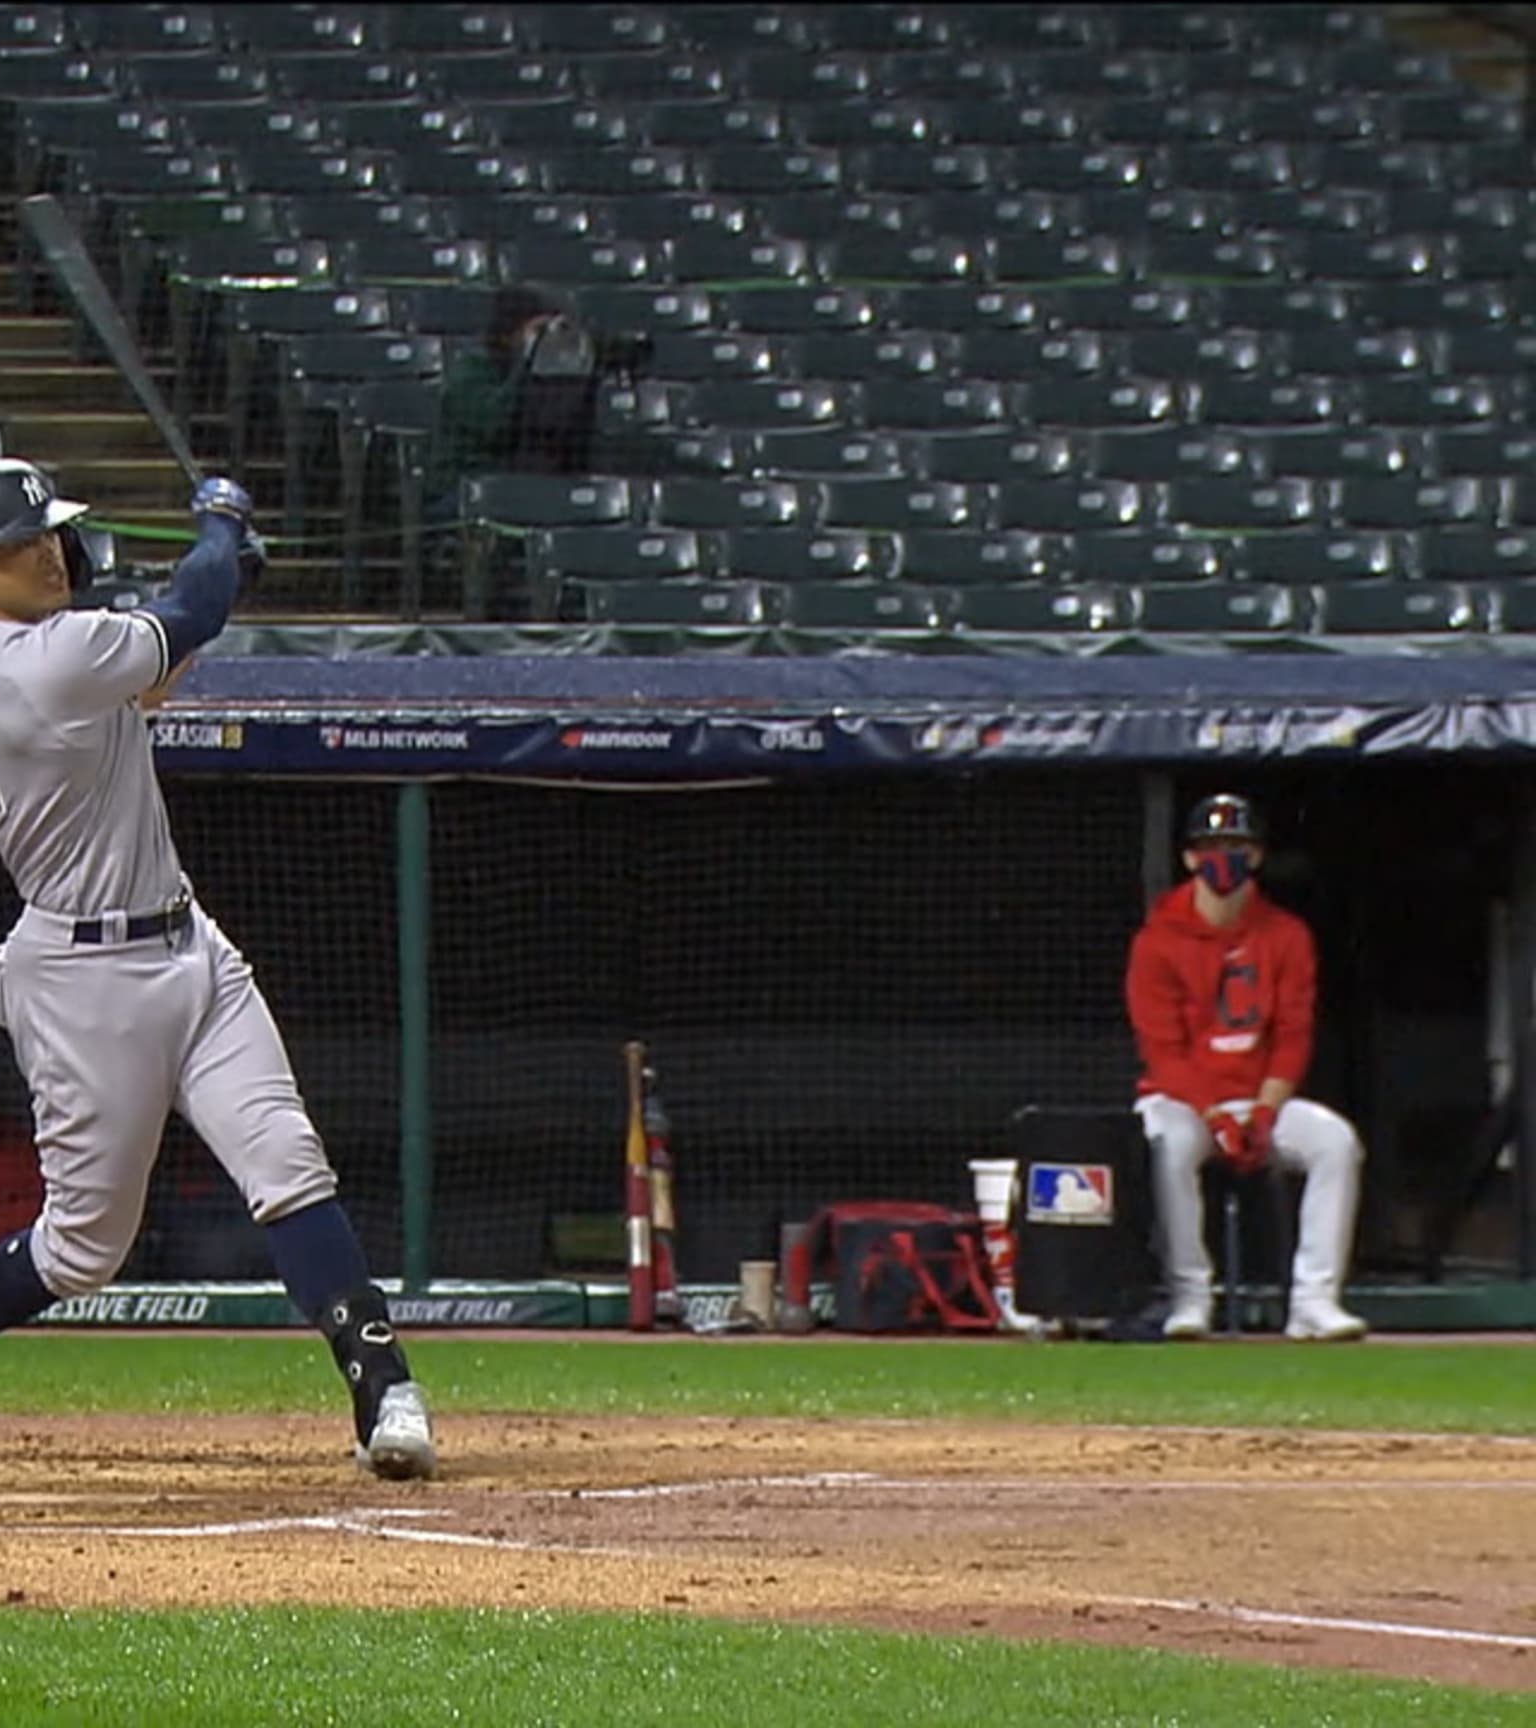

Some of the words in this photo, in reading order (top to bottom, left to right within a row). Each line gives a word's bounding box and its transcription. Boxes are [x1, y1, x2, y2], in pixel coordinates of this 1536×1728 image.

[155, 725, 221, 748] SEASON
[344, 731, 378, 748] MLB
[383, 731, 467, 748] NETWORK
[133, 1296, 209, 1321] FIELD
